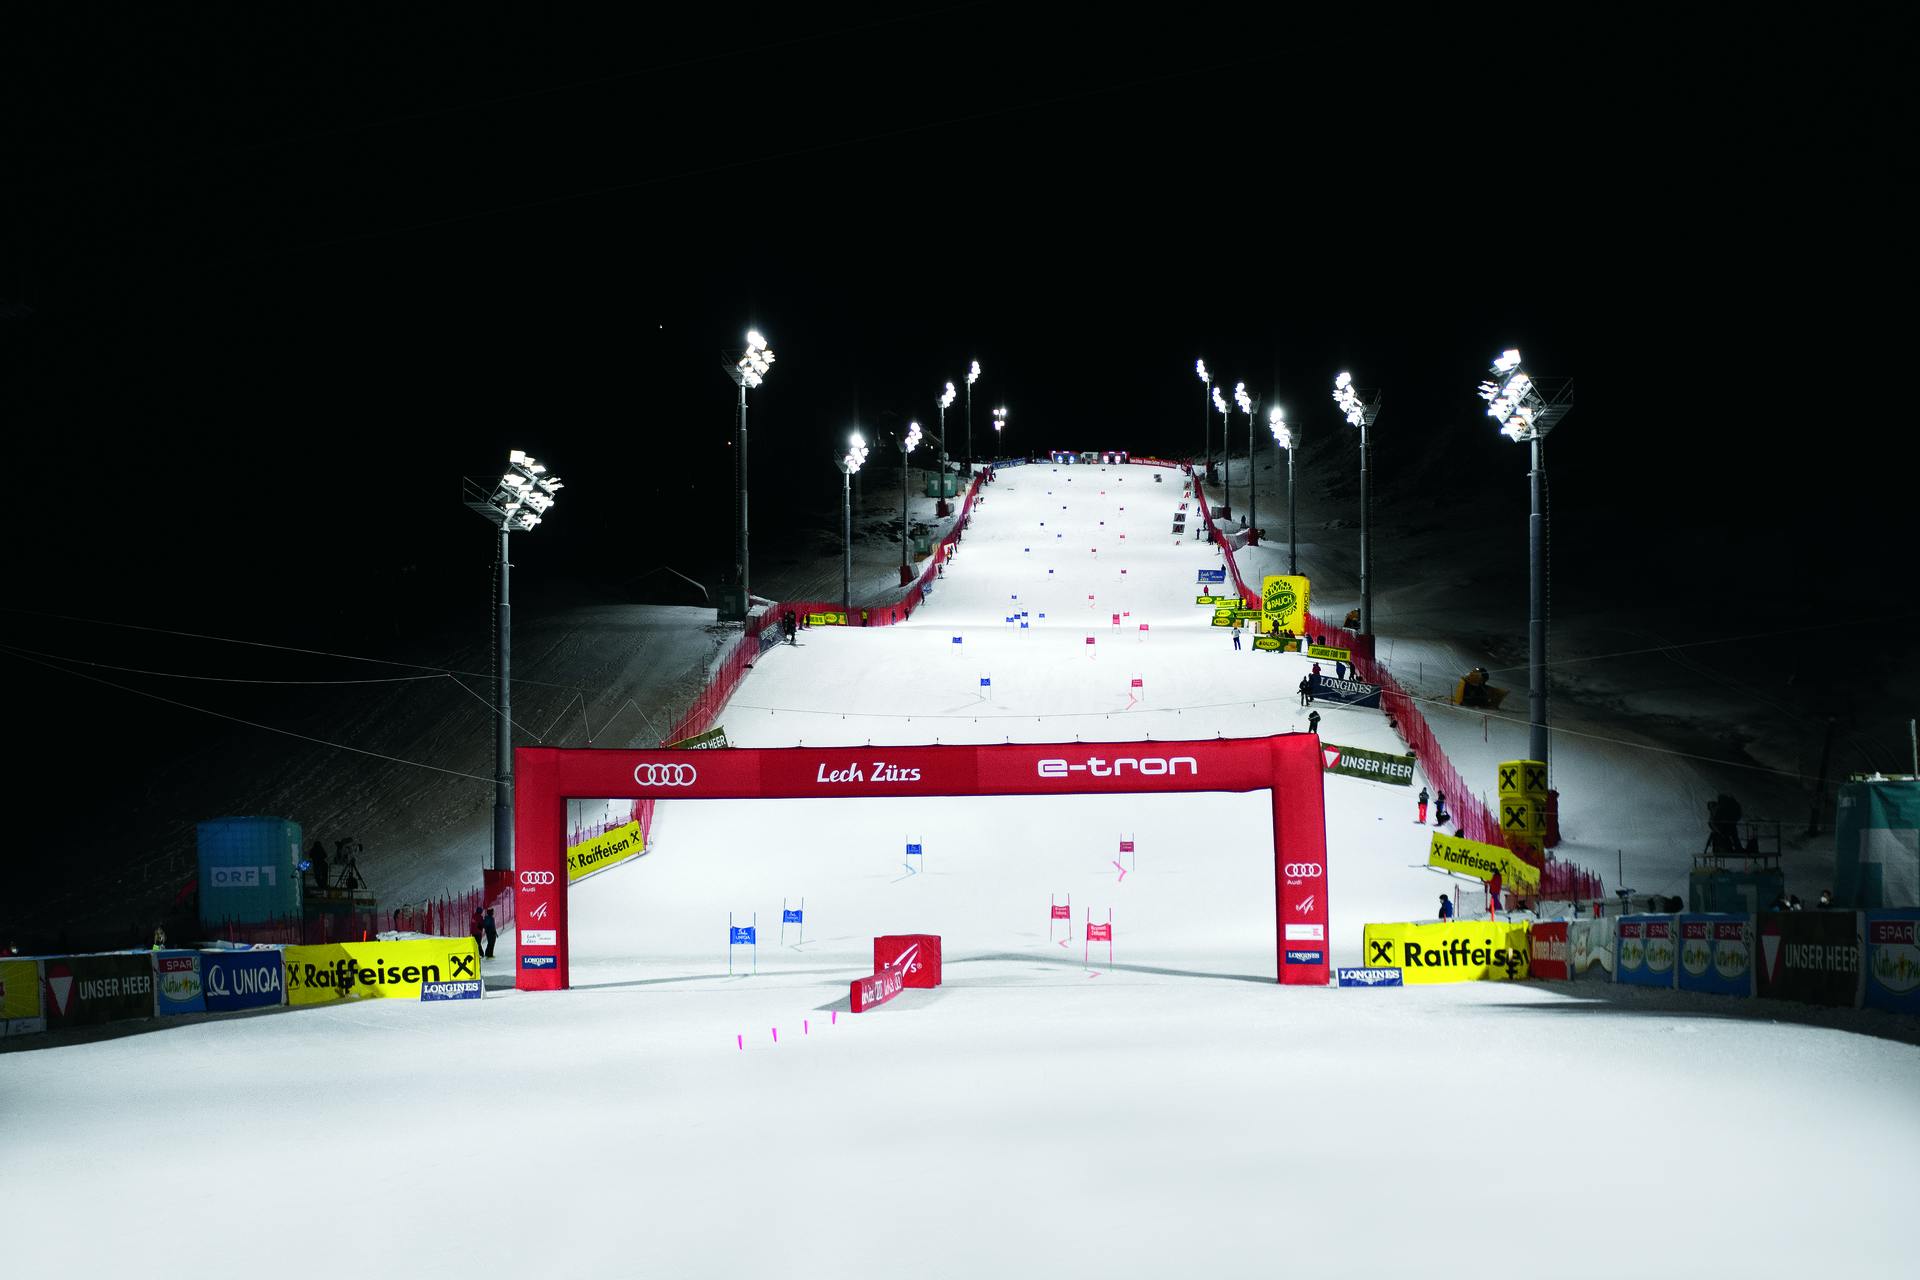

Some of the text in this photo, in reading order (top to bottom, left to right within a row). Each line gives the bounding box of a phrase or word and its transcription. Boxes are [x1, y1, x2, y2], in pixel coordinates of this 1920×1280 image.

[1270, 594, 1293, 609] RAUCH
[1320, 677, 1372, 694] LONGINES
[817, 762, 921, 782] Lech Zürs
[1038, 757, 1197, 777] e-tron
[1341, 755, 1412, 778] UNSER HEER
[578, 838, 629, 867] Raiffeisen
[1444, 846, 1496, 872] Raiffeisen
[216, 871, 255, 883] ORF
[1719, 926, 1743, 937] SPAR
[1880, 926, 1913, 941] SPAR
[166, 960, 192, 970] SPAR
[1785, 944, 1857, 972] UNSER HEER
[232, 967, 280, 995] UNIQA
[304, 959, 440, 988] Raiffeisen
[1341, 969, 1400, 979] LONGINES
[79, 976, 151, 1000] UNSER HEER
[423, 982, 479, 993] LONGINES
